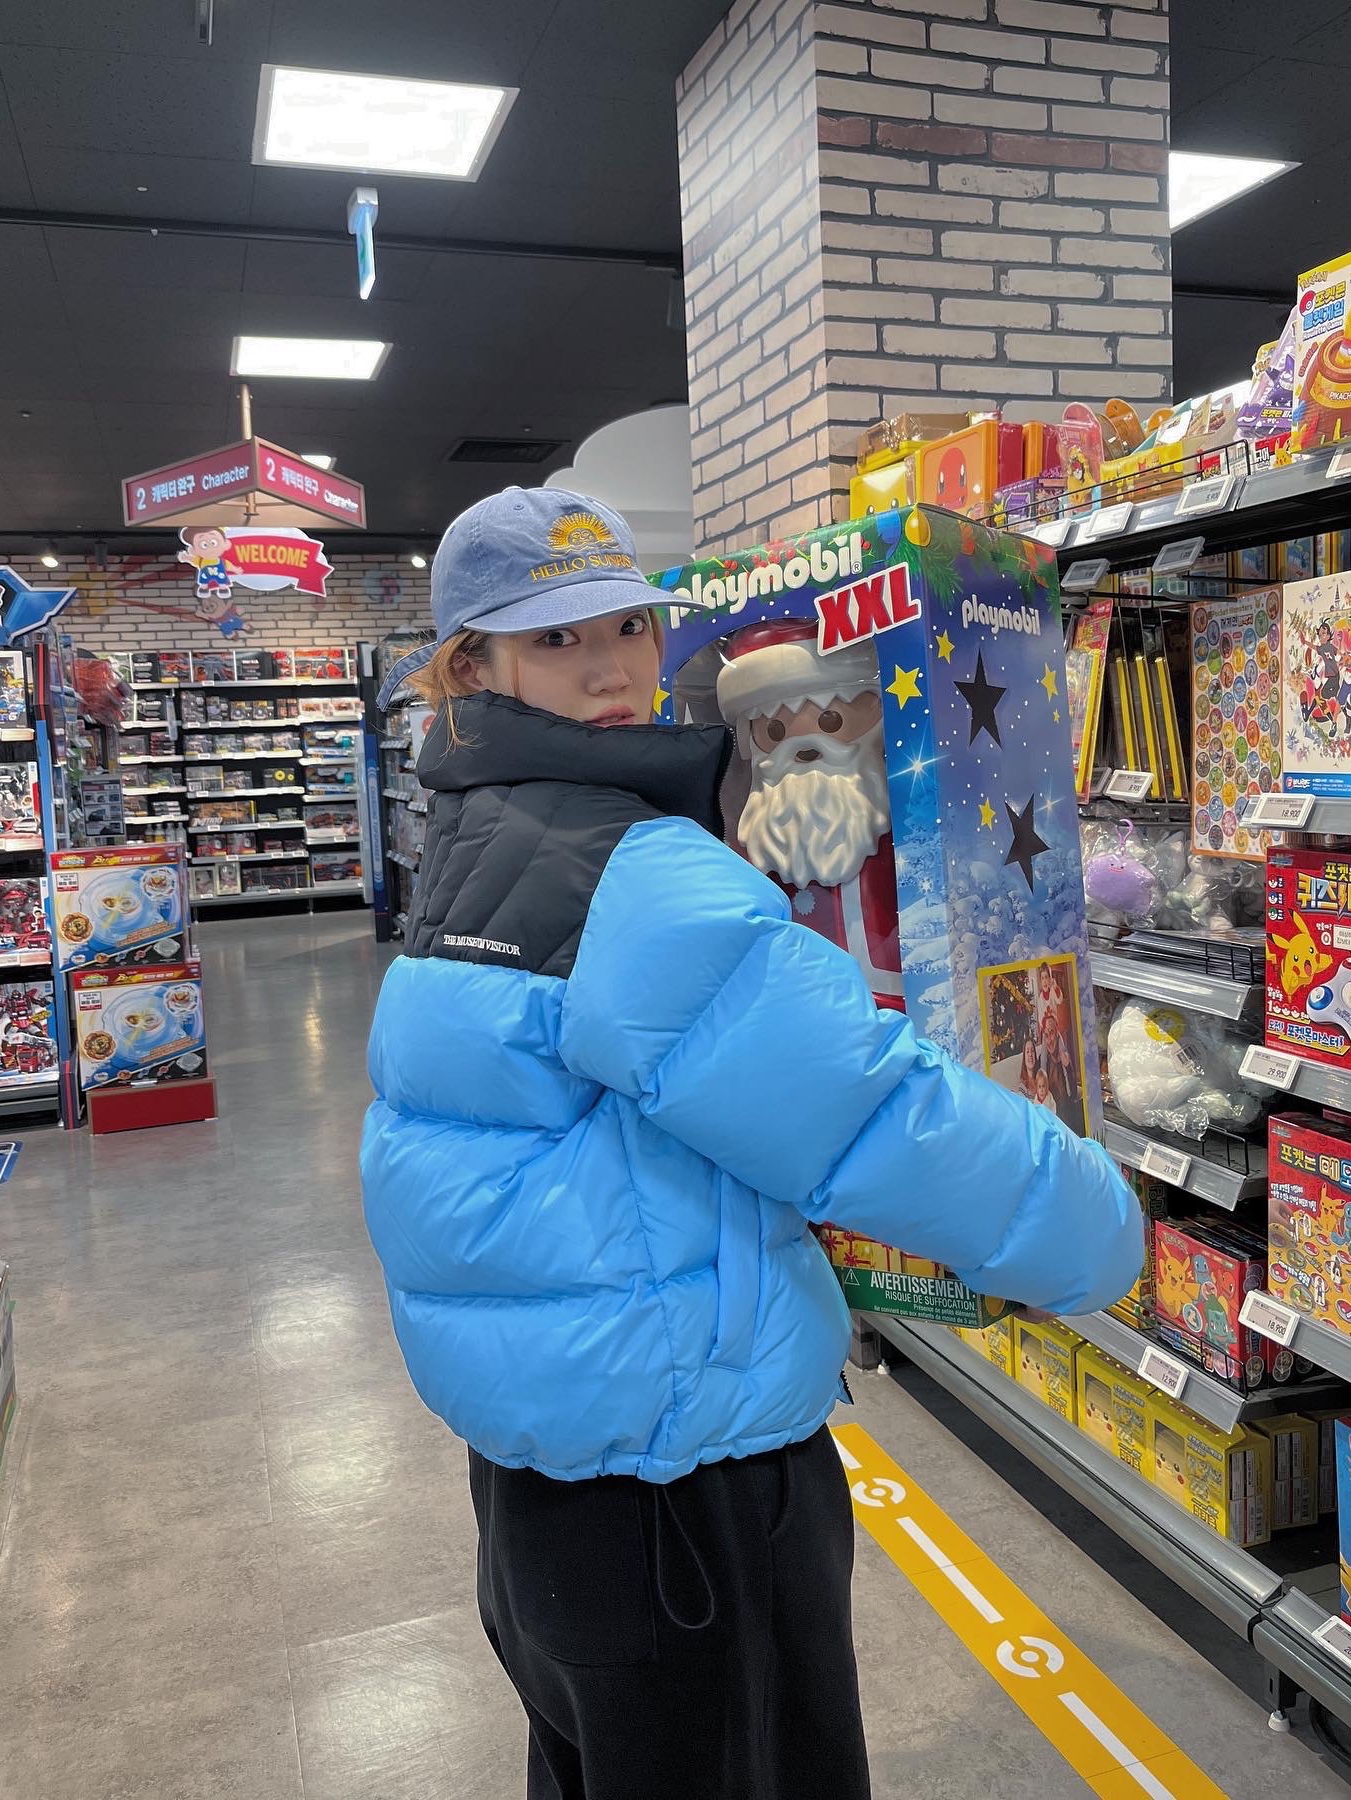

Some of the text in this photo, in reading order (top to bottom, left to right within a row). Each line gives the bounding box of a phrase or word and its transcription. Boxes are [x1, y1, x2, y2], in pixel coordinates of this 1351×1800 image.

[1314, 280, 1346, 309] 포켓몬
[265, 457, 276, 481] 2
[136, 487, 147, 510] 2
[202, 465, 250, 490] Character
[234, 543, 310, 569] WELCOME
[529, 557, 586, 583] HELLO
[669, 532, 862, 630] playmobil
[816, 563, 920, 654] XXL
[961, 593, 1041, 636] playmobil
[1325, 862, 1351, 881] 포켓
[443, 934, 456, 945] THE
[485, 939, 520, 956] VISITOR
[885, 1290, 911, 1303] RISQUE
[913, 1294, 922, 1304] DE
